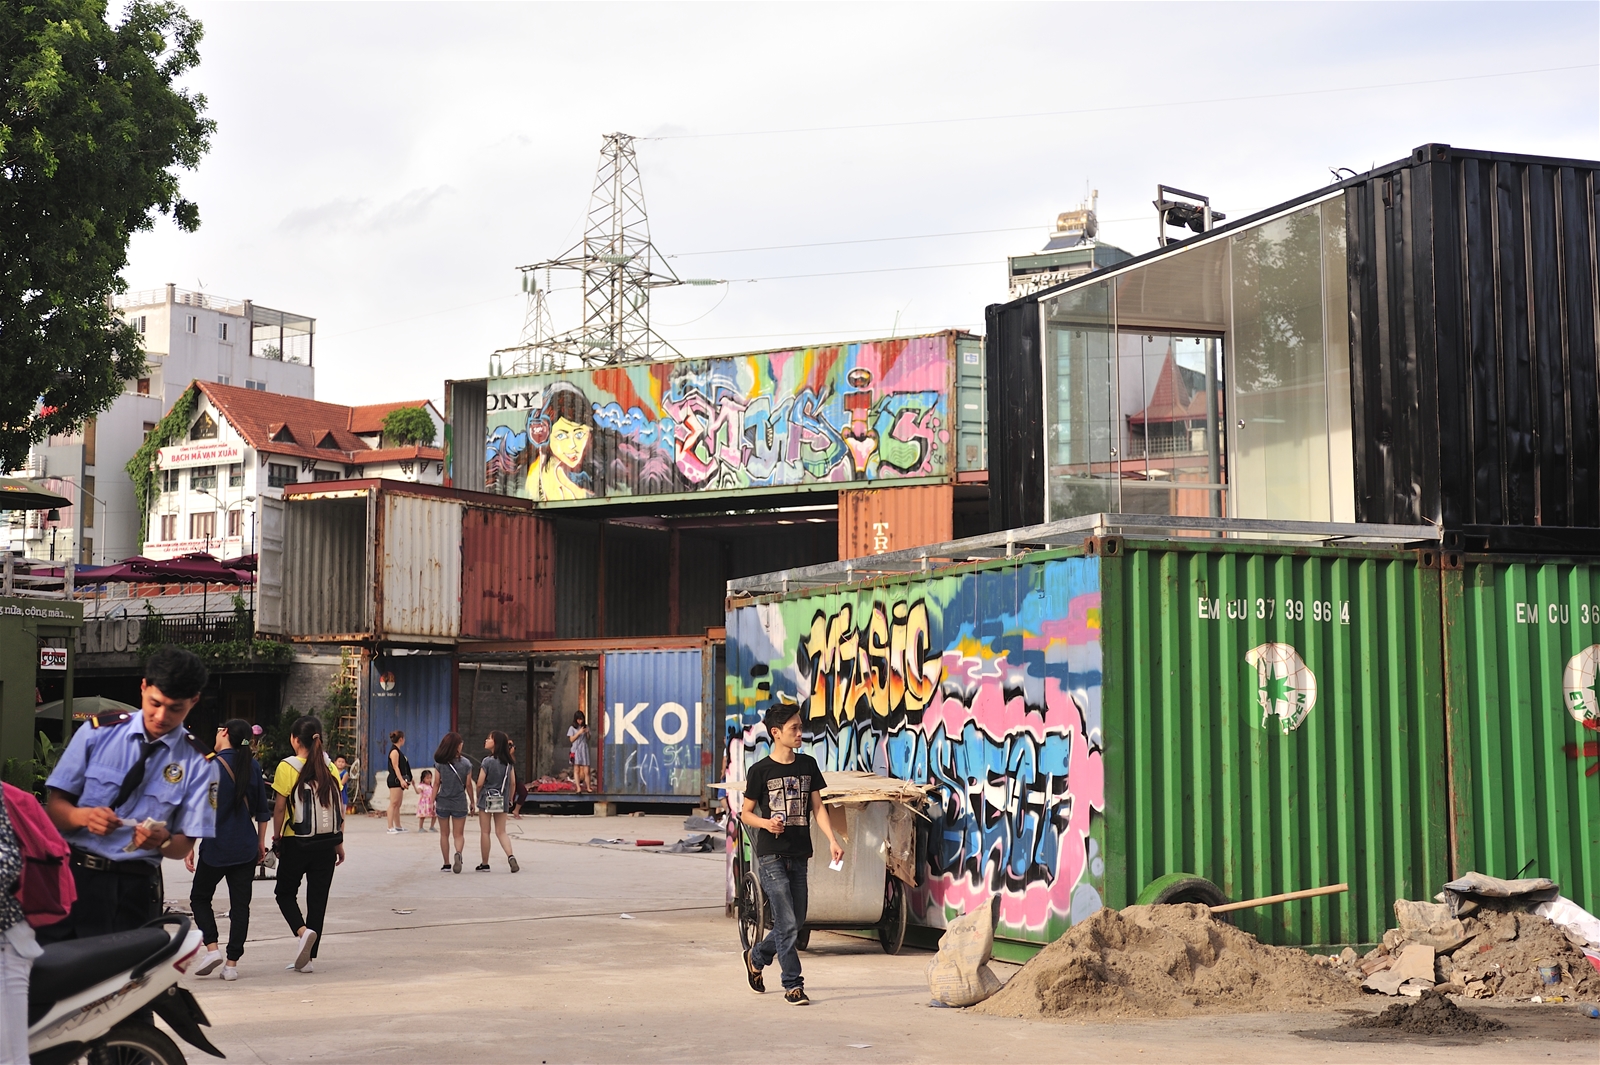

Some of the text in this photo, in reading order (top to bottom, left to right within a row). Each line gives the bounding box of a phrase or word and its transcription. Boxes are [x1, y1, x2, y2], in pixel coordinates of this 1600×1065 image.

[1031, 272, 1070, 282] HOTEL
[171, 454, 190, 463] BẠCH
[202, 452, 216, 461] VẠN
[217, 447, 238, 458] XUÂN
[873, 522, 889, 555] TR
